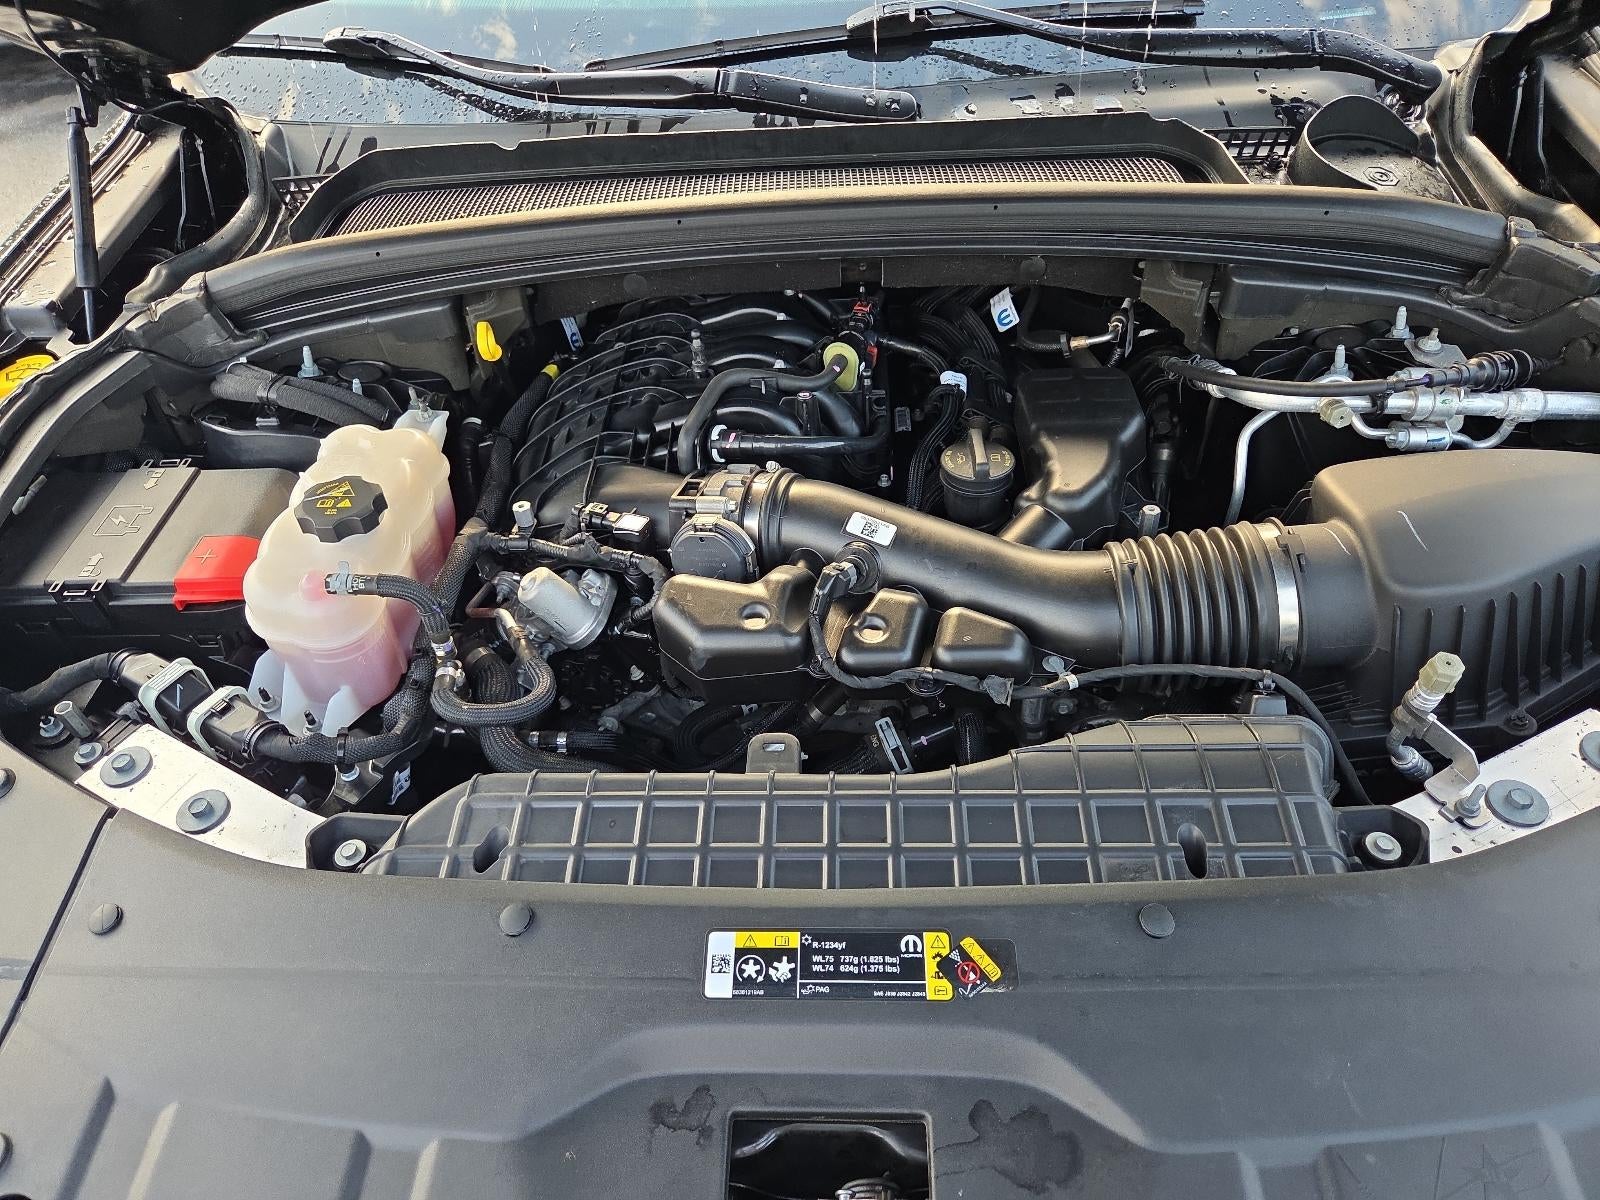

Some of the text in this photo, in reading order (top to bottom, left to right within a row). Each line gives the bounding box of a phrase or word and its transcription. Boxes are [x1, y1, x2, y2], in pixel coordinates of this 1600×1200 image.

[812, 941, 846, 950] R-1234yf
[812, 955, 835, 963] WL75
[840, 955, 859, 964] 737g
[885, 955, 900, 964] lbs)
[812, 964, 901, 974] WL74 624g (1.375 lbs)
